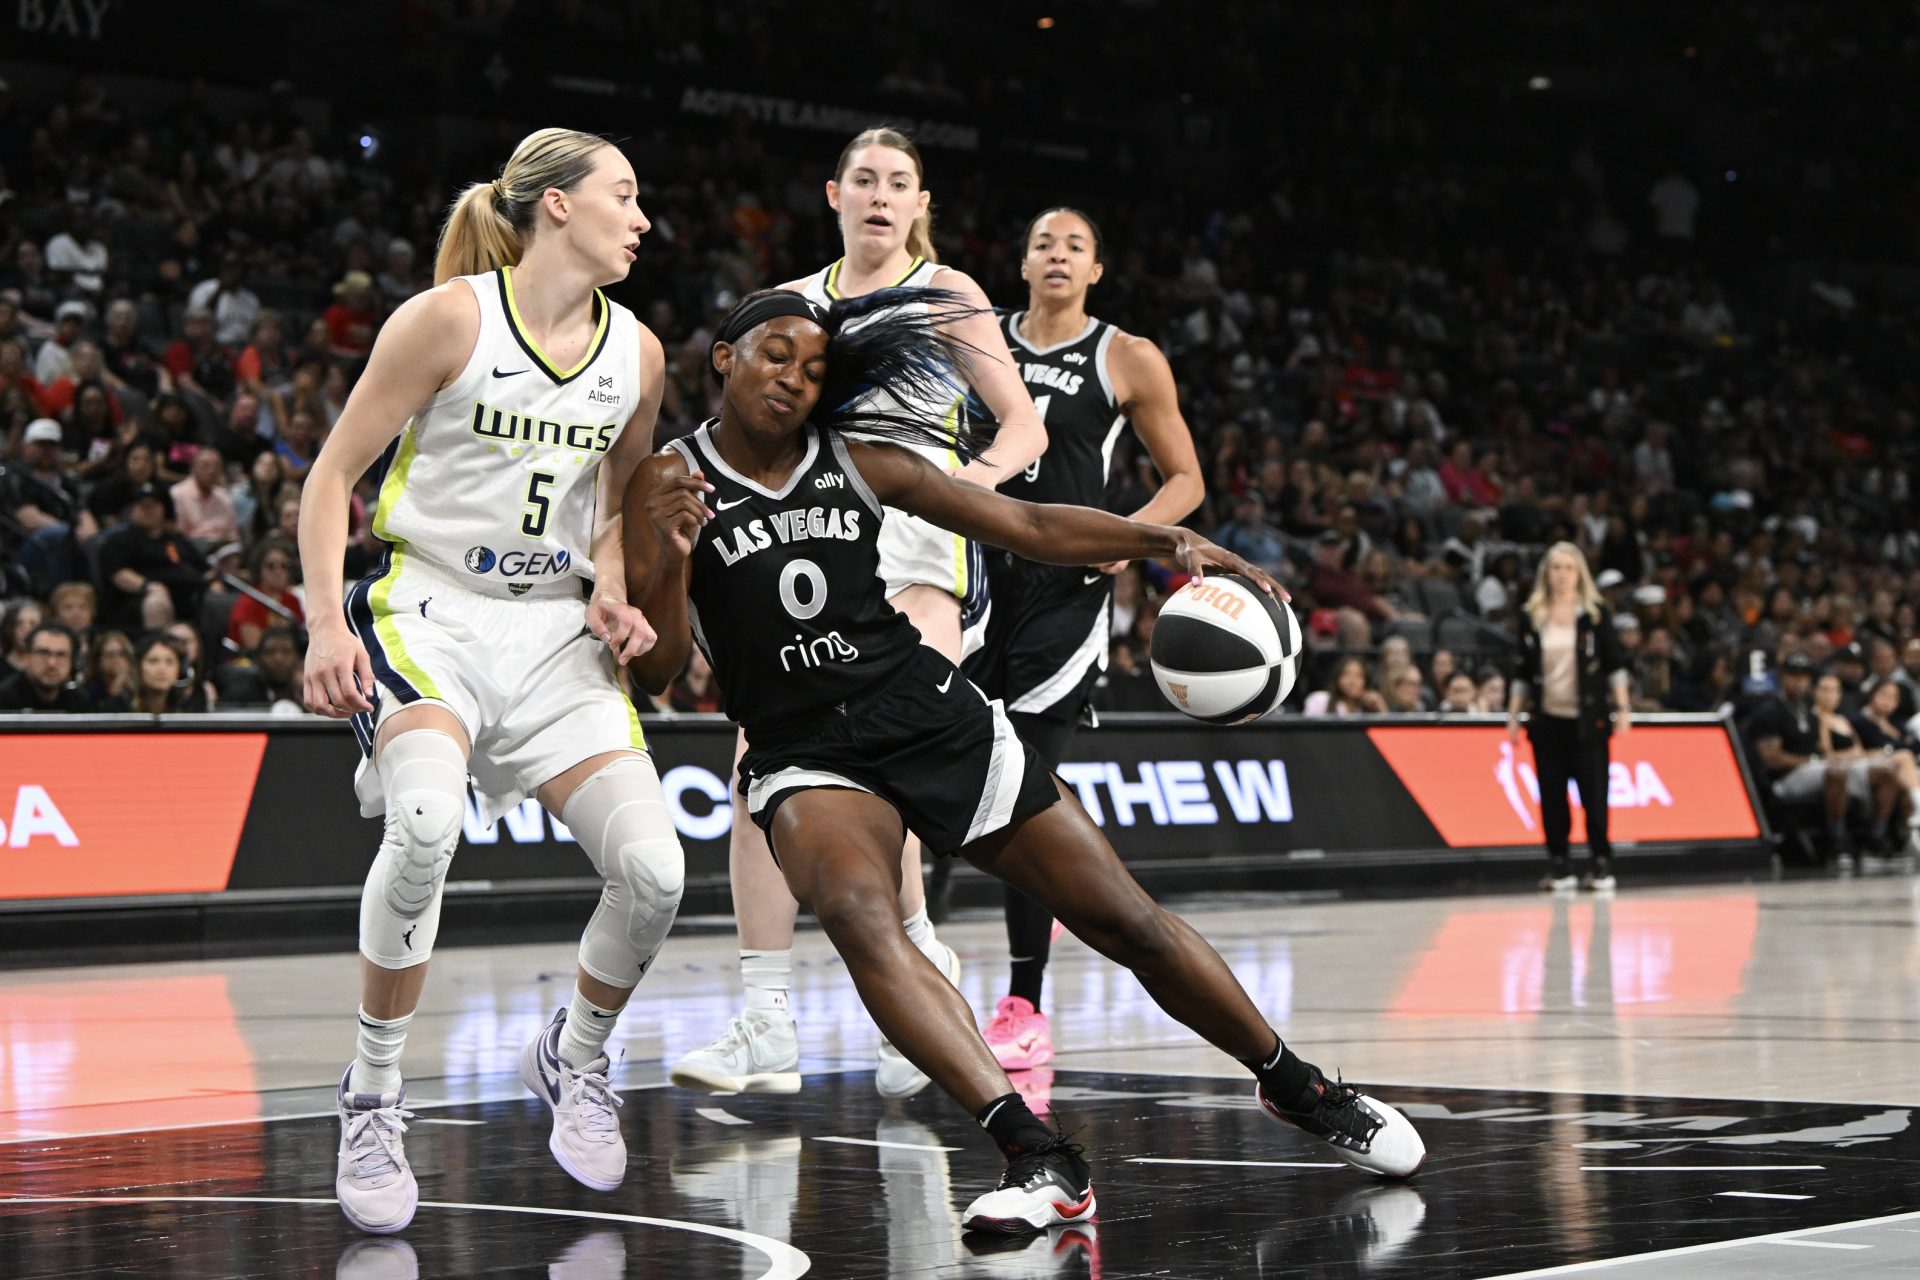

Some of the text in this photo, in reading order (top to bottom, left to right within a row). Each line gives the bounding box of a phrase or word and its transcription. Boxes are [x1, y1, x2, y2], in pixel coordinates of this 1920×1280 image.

[1024, 362, 1085, 396] VEGAS
[1062, 352, 1087, 366] ally
[588, 389, 621, 405] Albert
[471, 400, 619, 456] WINGS
[814, 472, 845, 489] ally
[520, 470, 559, 541] 5
[712, 507, 861, 567] LAS VEGAS
[778, 558, 828, 620] 0
[780, 630, 859, 672] ring
[1056, 759, 1294, 827] THE W
